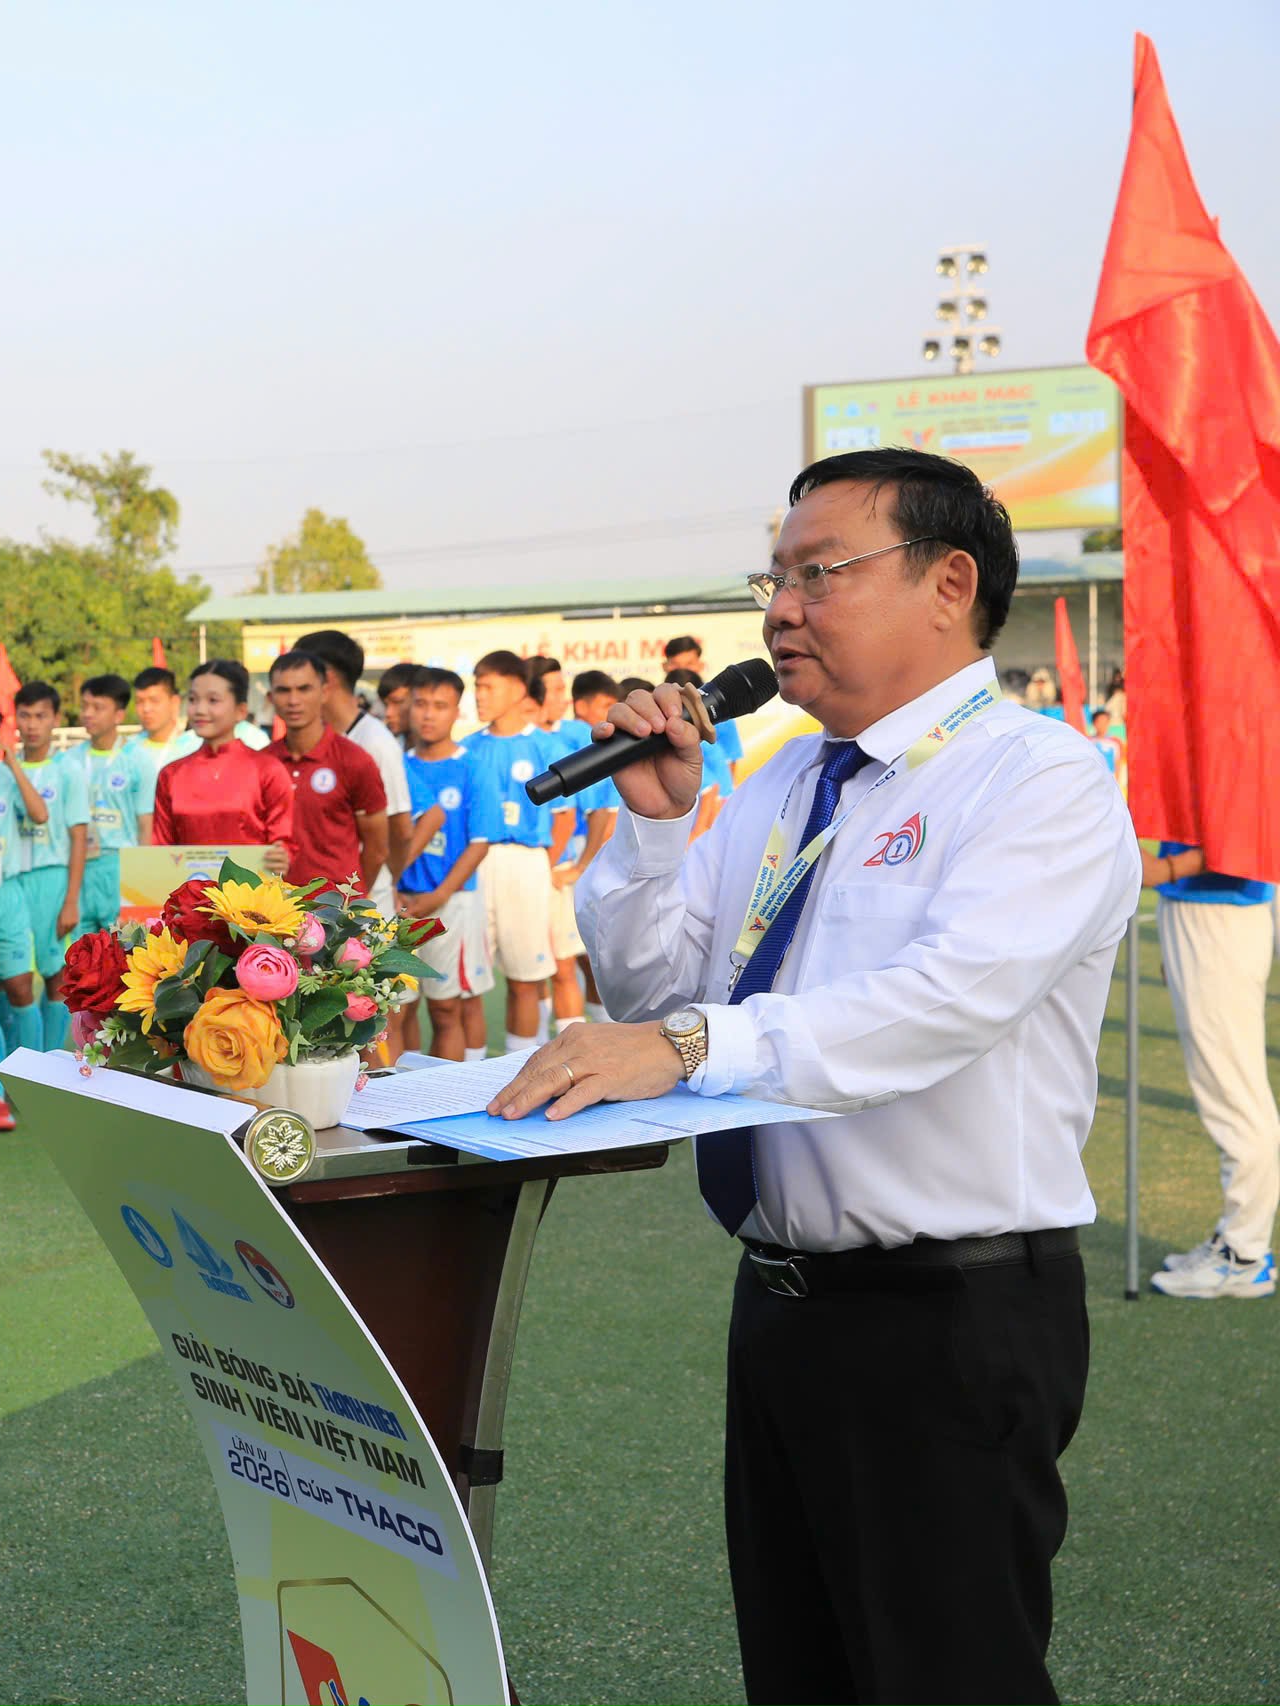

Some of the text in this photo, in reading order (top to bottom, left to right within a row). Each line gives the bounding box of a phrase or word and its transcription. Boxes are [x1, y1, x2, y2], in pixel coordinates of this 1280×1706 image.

[563, 639, 629, 662] KHAI
[172, 1332, 215, 1369] GIẢI
[214, 1347, 278, 1393] BÓNG
[278, 1371, 318, 1408] ĐÁ
[190, 1372, 427, 1490] SINH VIÊN VIỆT NAM
[232, 1434, 268, 1461] LẦN IV
[228, 1449, 444, 1556] 2026 CÚP THACO
